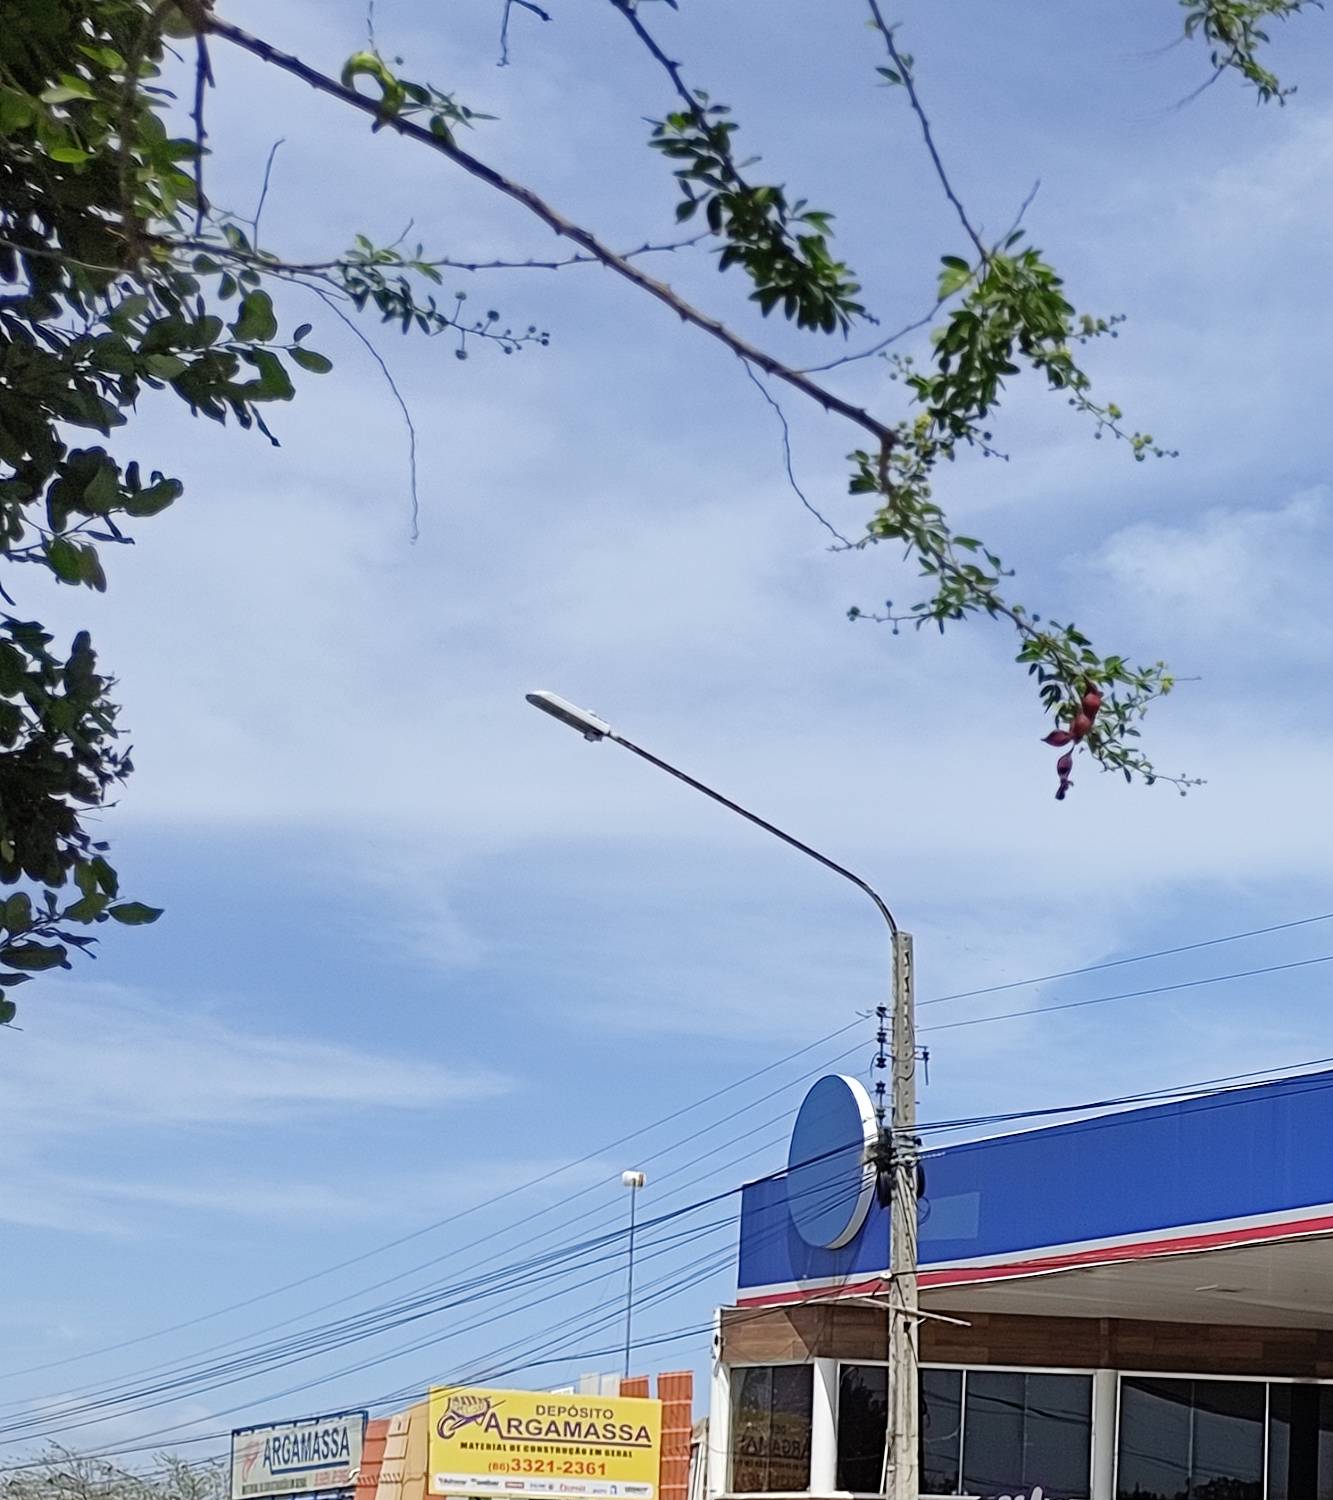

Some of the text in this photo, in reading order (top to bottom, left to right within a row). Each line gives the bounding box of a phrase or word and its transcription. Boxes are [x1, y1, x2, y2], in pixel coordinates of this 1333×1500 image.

[535, 1404, 614, 1420] DEPÓSITO
[484, 1411, 653, 1443] ARGAMASSA
[262, 1426, 351, 1468] ARGAMASSA
[460, 1441, 507, 1452] MATERIAL
